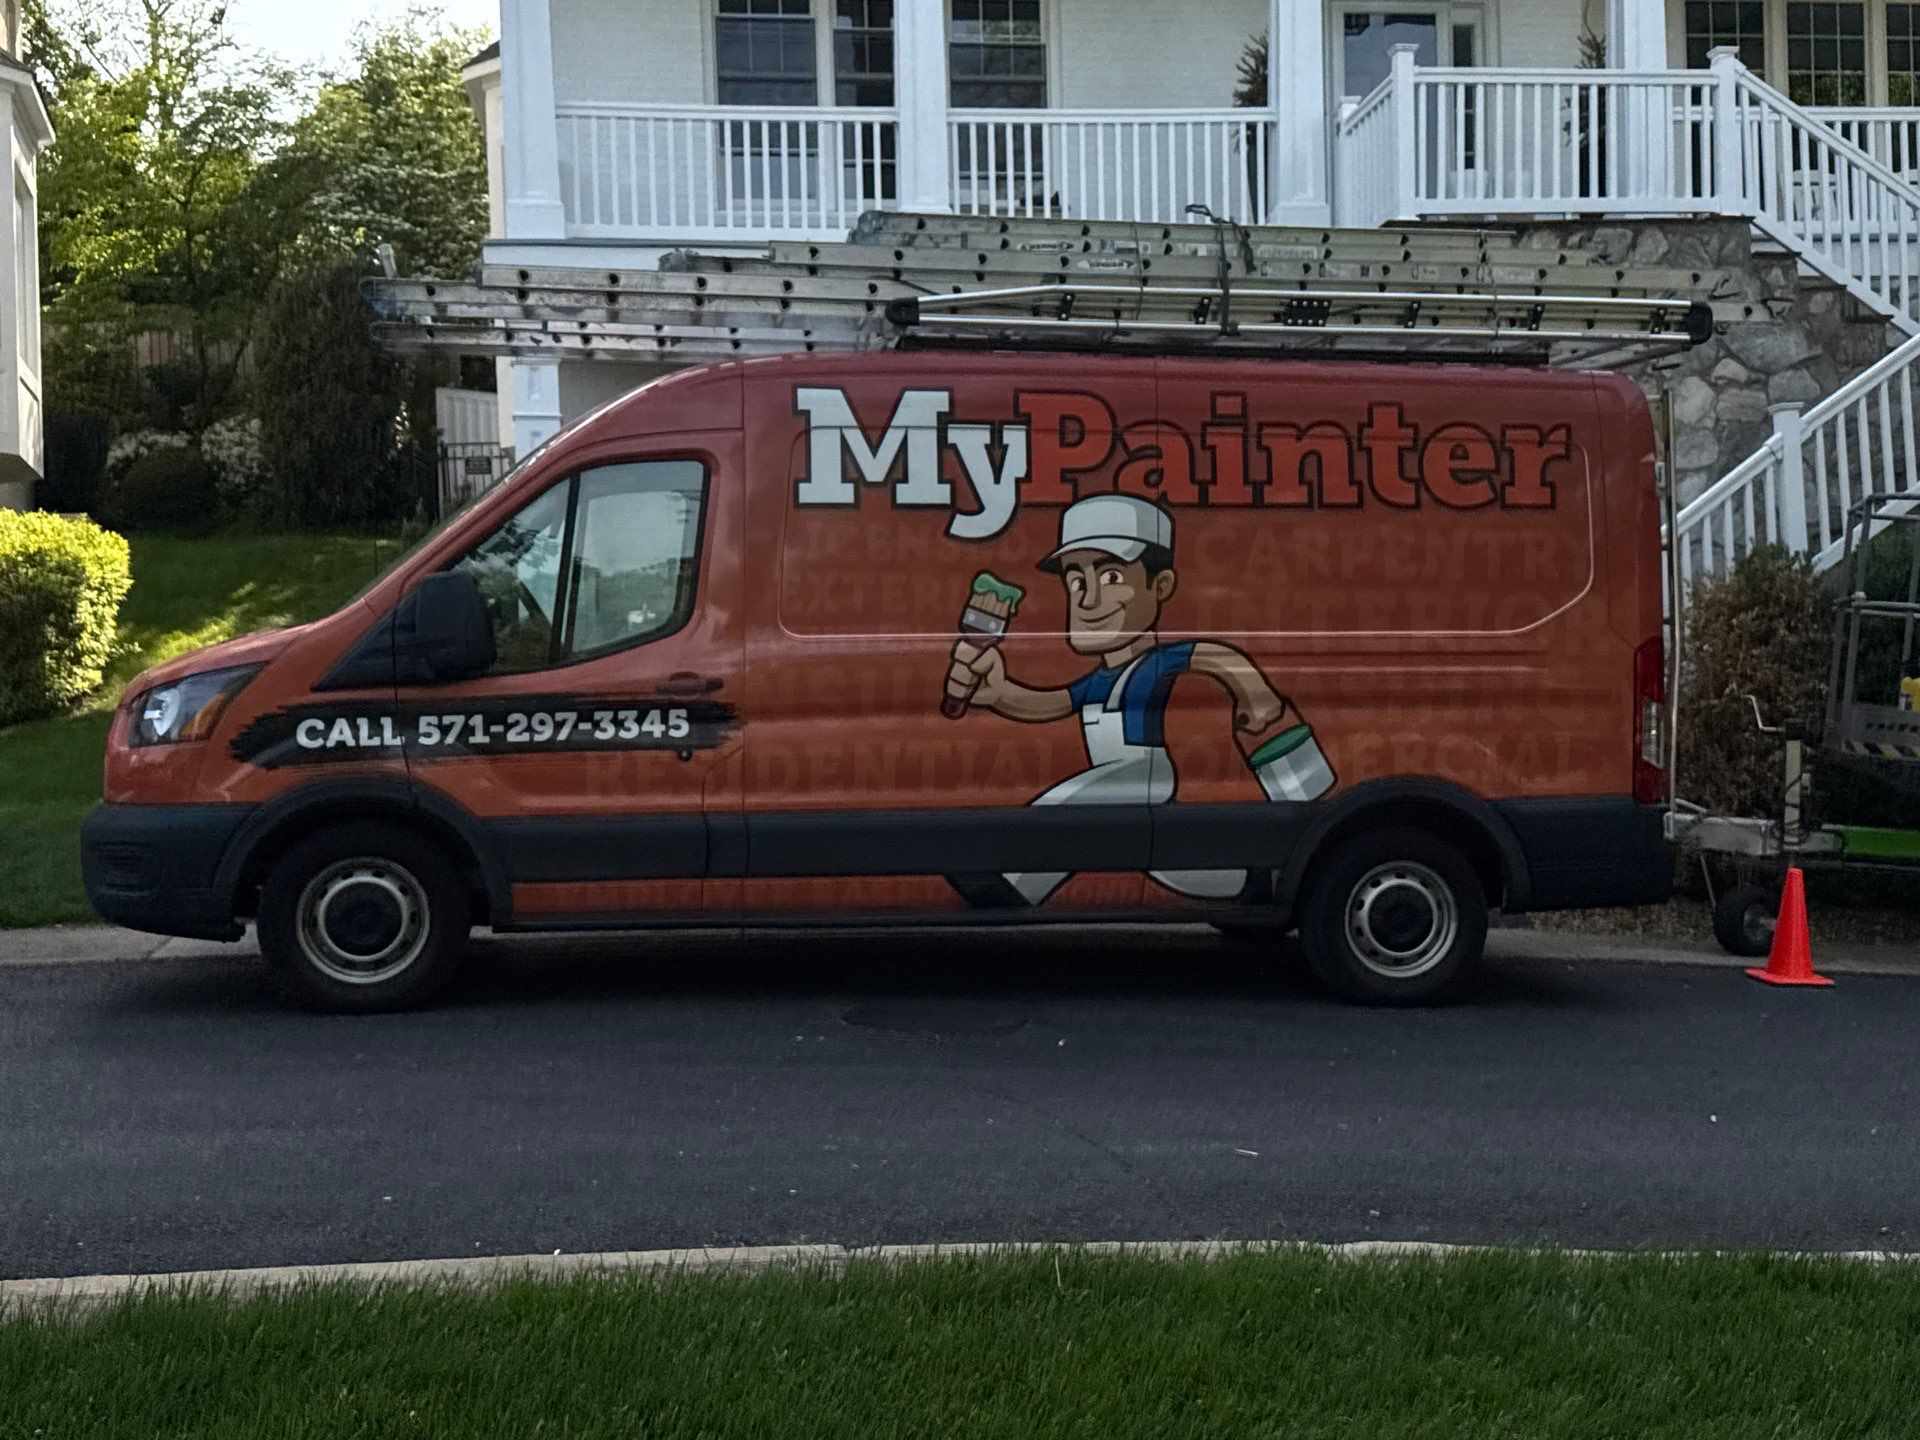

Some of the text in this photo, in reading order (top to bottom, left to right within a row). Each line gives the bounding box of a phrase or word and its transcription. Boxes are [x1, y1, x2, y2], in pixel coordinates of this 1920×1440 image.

[795, 386, 1573, 539] MyPainter
[295, 708, 690, 750] CALL 571-297-3345
